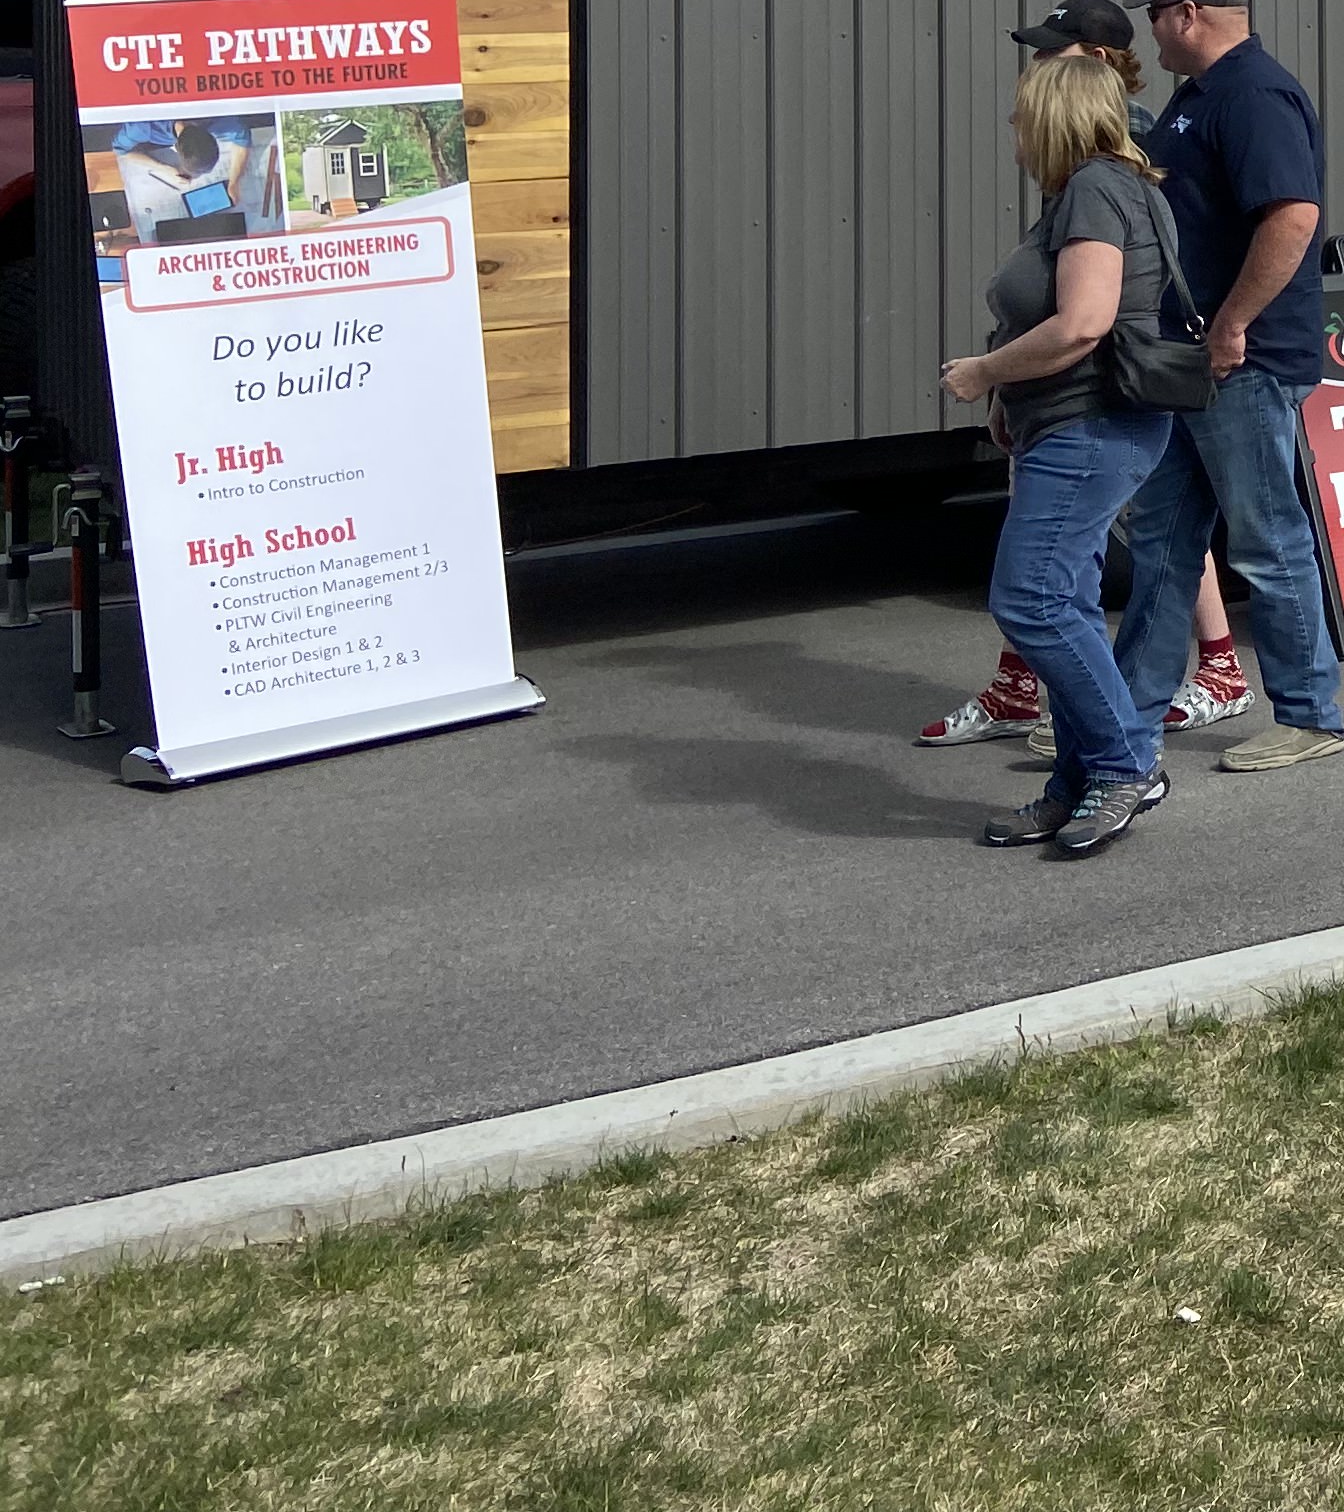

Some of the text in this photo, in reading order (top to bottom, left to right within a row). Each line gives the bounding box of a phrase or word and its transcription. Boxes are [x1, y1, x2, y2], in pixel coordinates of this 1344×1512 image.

[102, 19, 432, 72] CTE PATHWAYS
[135, 62, 408, 96] YOUR BRIDGE TO THE FUTURE
[157, 233, 419, 276] ARCHITECTURE, ENGINEERING
[212, 260, 370, 290] & CONSTRUCTION
[213, 319, 384, 362] Do you like
[235, 362, 371, 403] to build?
[174, 442, 284, 484] Jr. High
[208, 467, 365, 502] Intro to Construction
[187, 518, 357, 568] High School
[219, 543, 430, 589] Construction Management 1
[222, 559, 449, 610] Construction Management 2/3
[225, 591, 393, 633] PLTW Civil Engineering
[228, 623, 337, 653] & Architecture
[231, 636, 383, 675] Interior Design 1 & 2
[234, 649, 420, 697] CAD Architecture 1, 2 & 3
